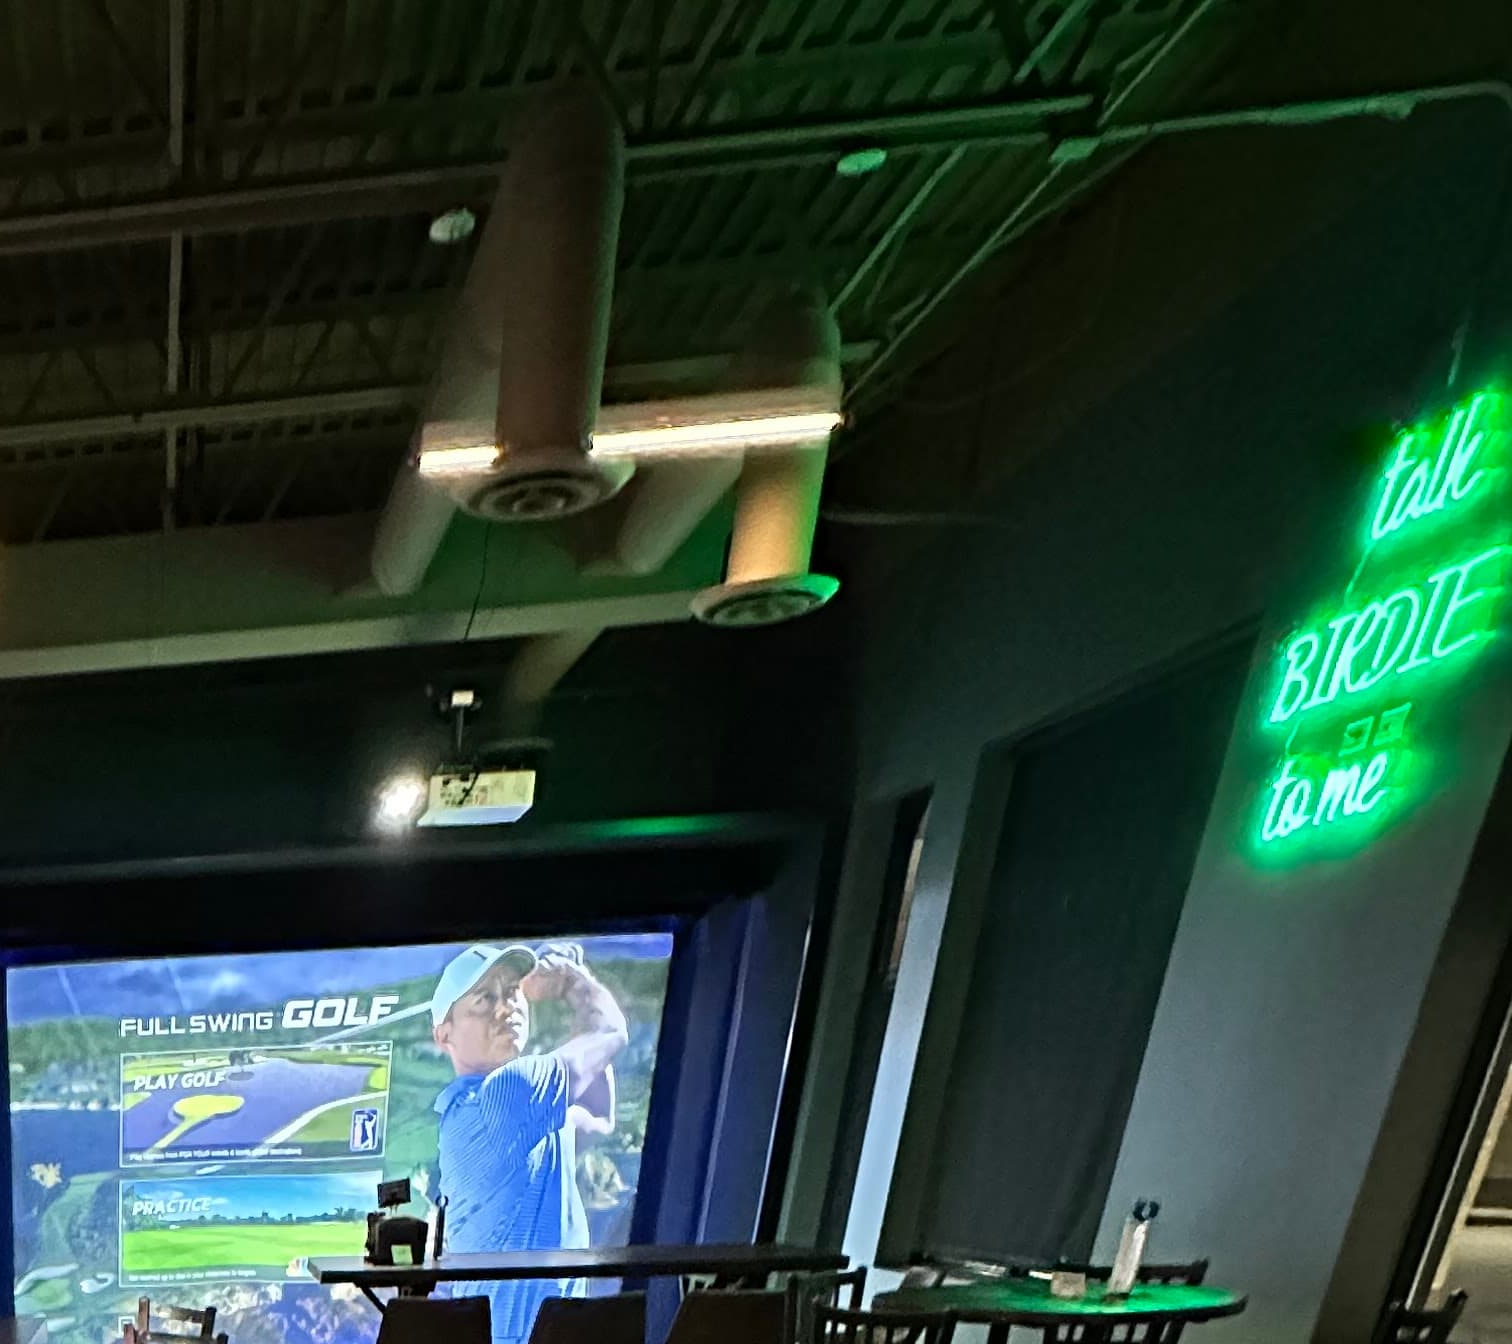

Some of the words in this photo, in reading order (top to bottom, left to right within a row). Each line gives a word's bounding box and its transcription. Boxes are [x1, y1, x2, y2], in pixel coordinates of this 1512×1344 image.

[1372, 393, 1485, 540] talk
[1269, 545, 1512, 723] BIRDIE
[1261, 760, 1310, 840] to
[1313, 753, 1388, 826] me
[120, 1015, 186, 1037] FULL
[189, 1011, 274, 1034] SWING
[281, 994, 399, 1029] GOLF
[133, 1072, 178, 1091] PLAY
[180, 1069, 227, 1088] GOLF
[132, 1196, 213, 1217] PRACTICE
